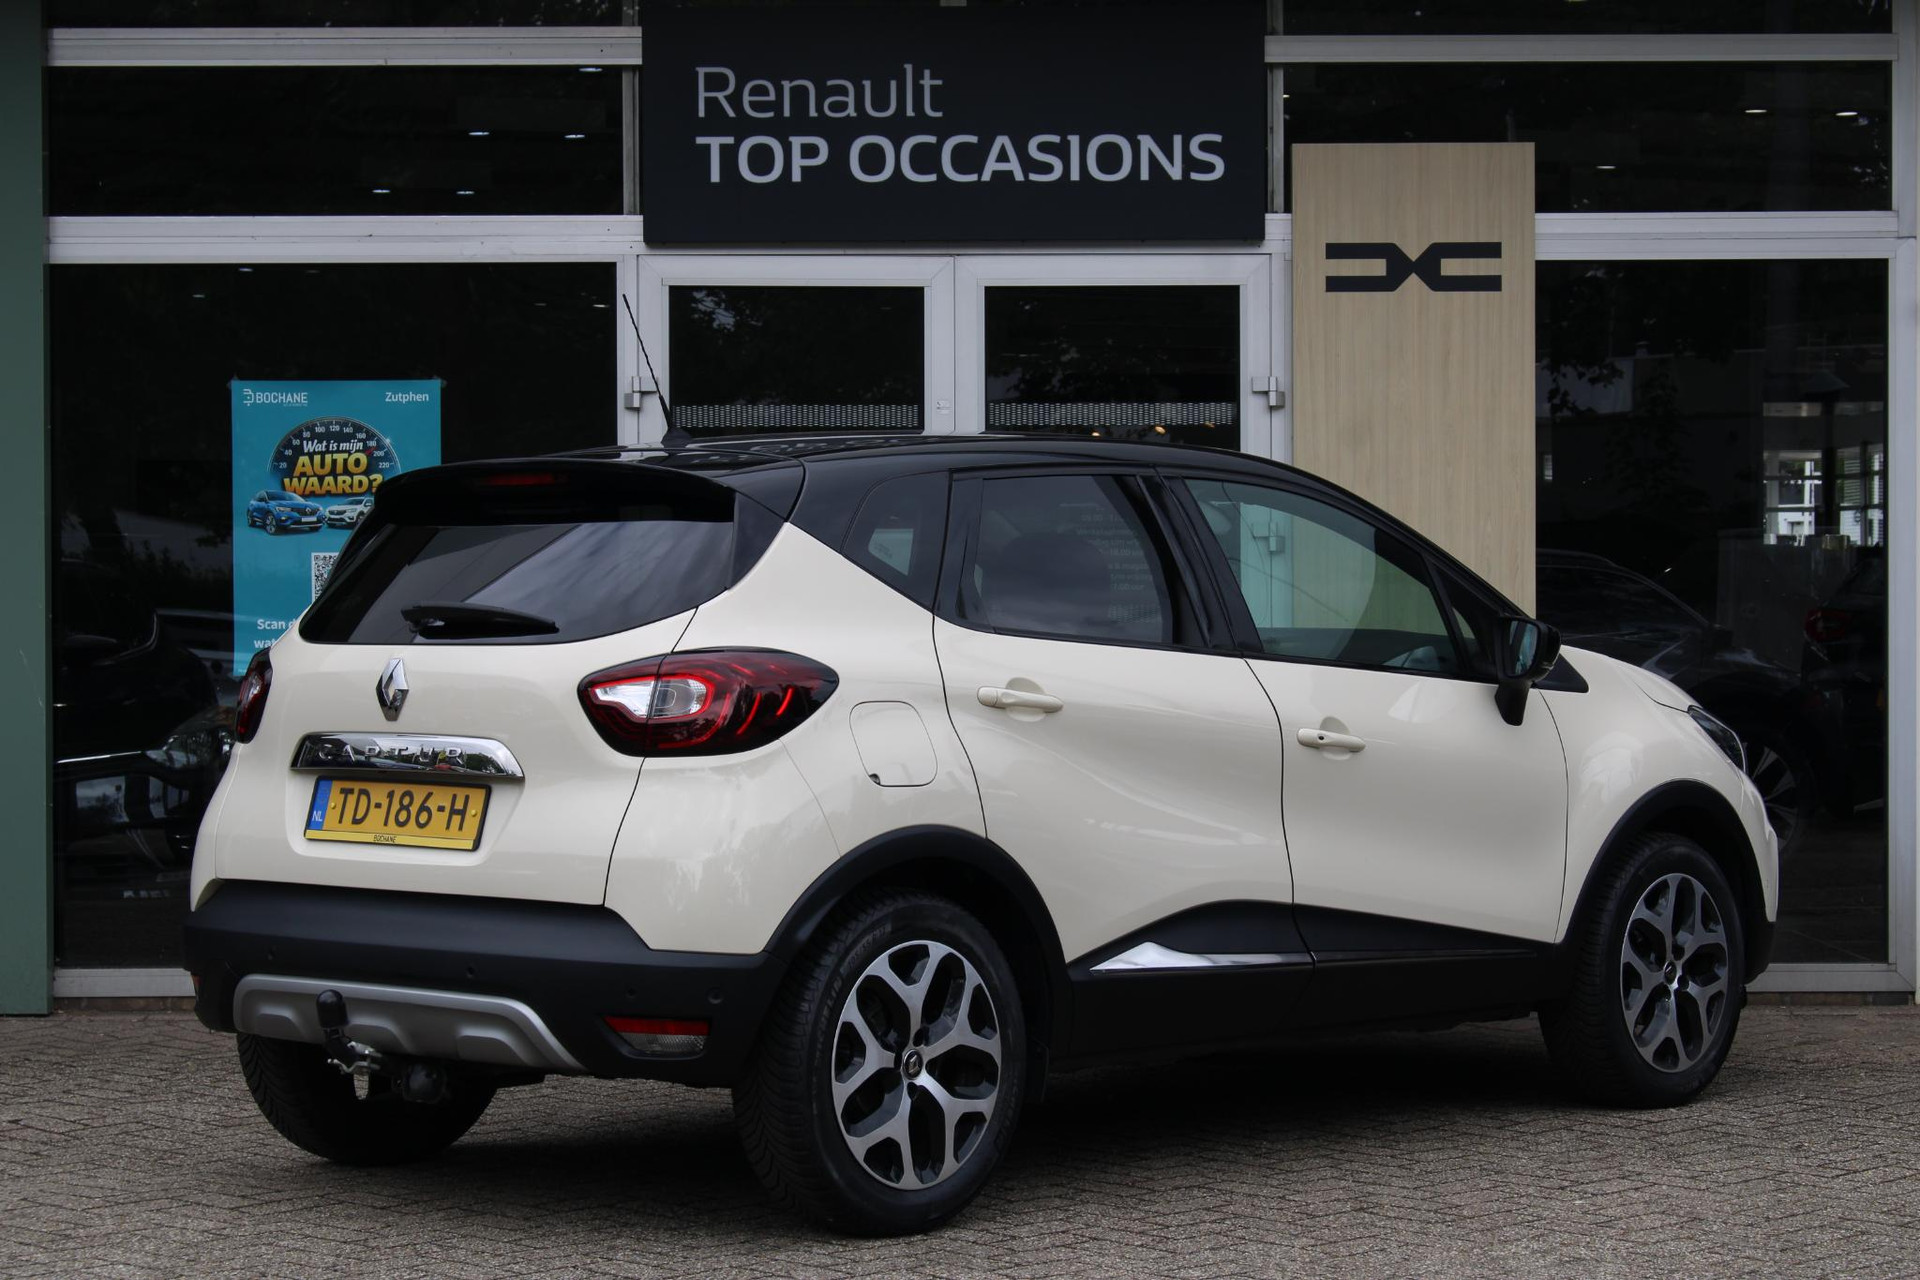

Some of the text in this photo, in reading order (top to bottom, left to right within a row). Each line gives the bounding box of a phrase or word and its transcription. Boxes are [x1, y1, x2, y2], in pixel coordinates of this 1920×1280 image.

[695, 63, 943, 118] Renault
[695, 132, 1225, 184] TOP OCCASIONS
[255, 392, 309, 404] BOCHANE
[385, 391, 429, 405] Zutphen
[302, 440, 364, 453] Wat is mijn
[292, 452, 368, 477] AUTO
[283, 473, 384, 496] WAARD?
[256, 618, 286, 630] Scan
[311, 810, 323, 822] NL
[338, 787, 471, 832] TD-186-H
[373, 834, 397, 844] BOCHANE
